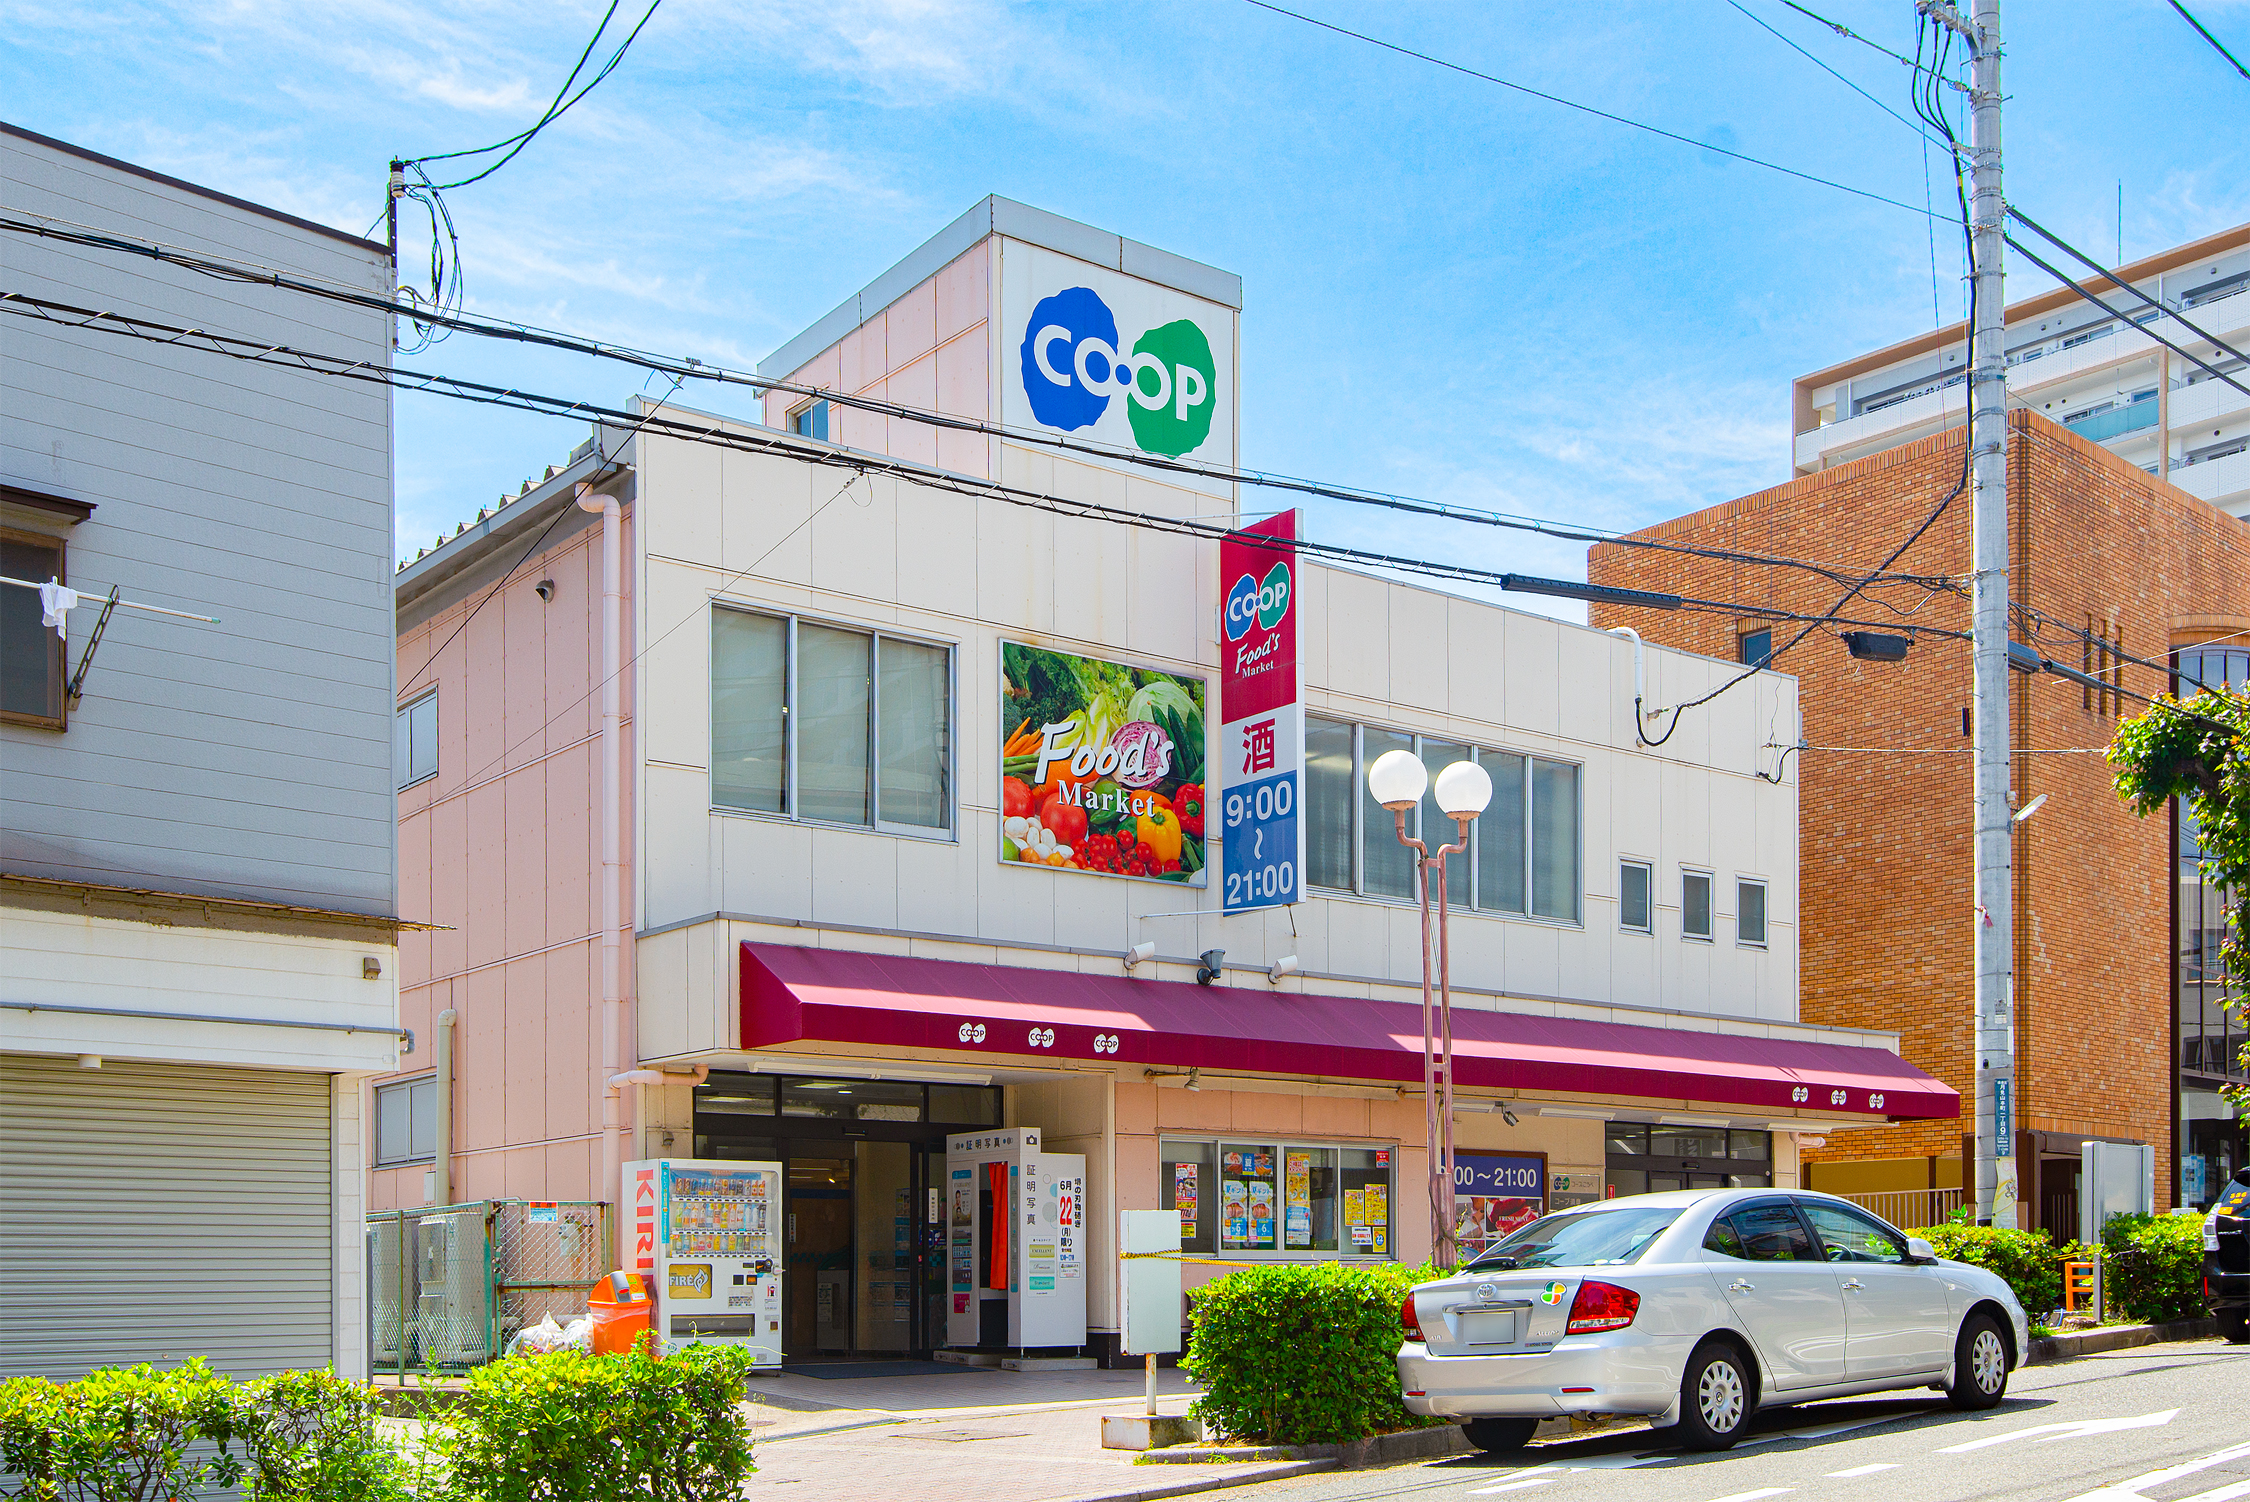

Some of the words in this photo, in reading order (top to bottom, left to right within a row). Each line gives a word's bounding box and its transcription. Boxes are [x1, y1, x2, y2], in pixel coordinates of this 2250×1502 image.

[1234, 632, 1281, 674] Food's
[1241, 660, 1274, 678] Market
[1034, 720, 1175, 785] Food's
[1242, 718, 1276, 776] 酒
[1056, 779, 1157, 818] Market
[1226, 780, 1293, 828] 9:00
[1227, 861, 1294, 906] 21:00
[966, 1137, 1001, 1151] 証明写真
[1999, 1126, 2007, 1135] 9
[1026, 1164, 1036, 1225] 証明写真
[1059, 1180, 1072, 1191] 6月
[1059, 1195, 1073, 1226] 22
[1060, 1237, 1073, 1247] 限り
